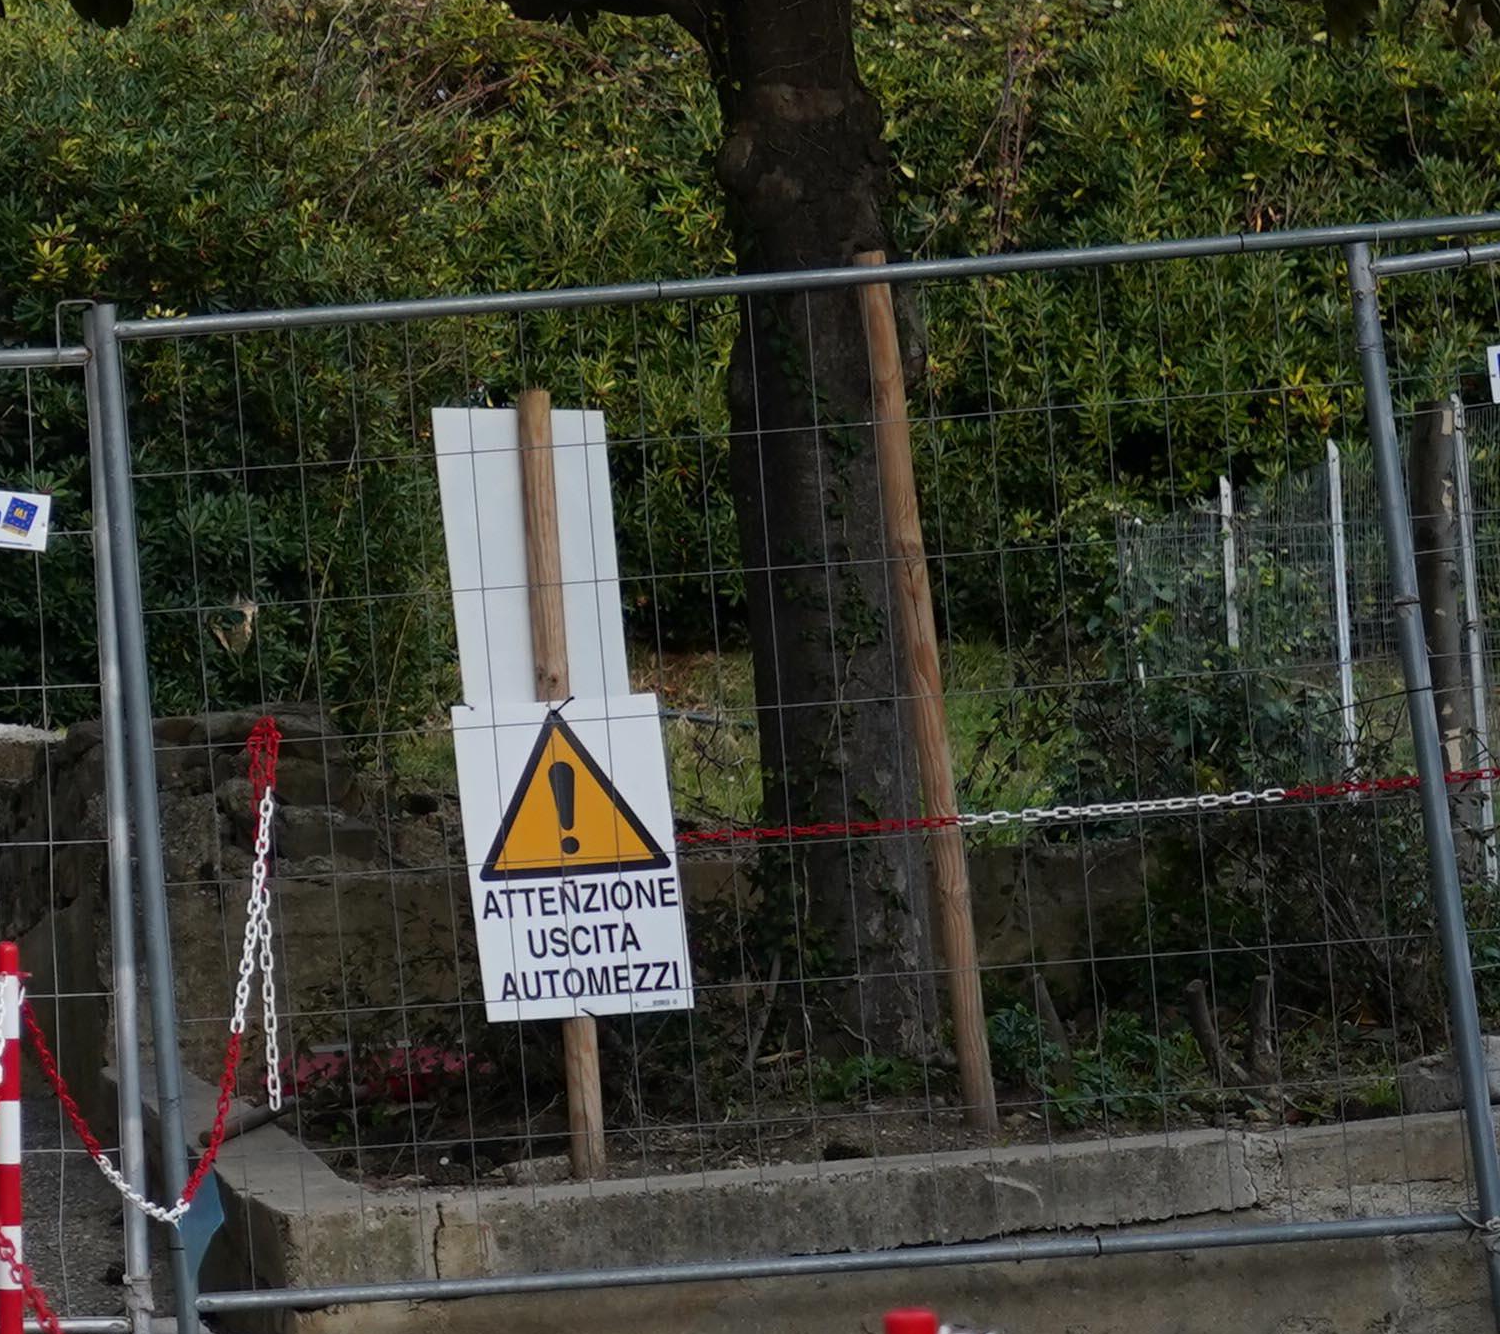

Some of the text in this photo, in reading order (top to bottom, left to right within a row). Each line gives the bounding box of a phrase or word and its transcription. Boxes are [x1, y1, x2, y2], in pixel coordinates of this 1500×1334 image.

[483, 877, 678, 919] ATTENZIONE
[527, 923, 642, 959] USCITA
[502, 961, 680, 1001] AUTOMEZZI
